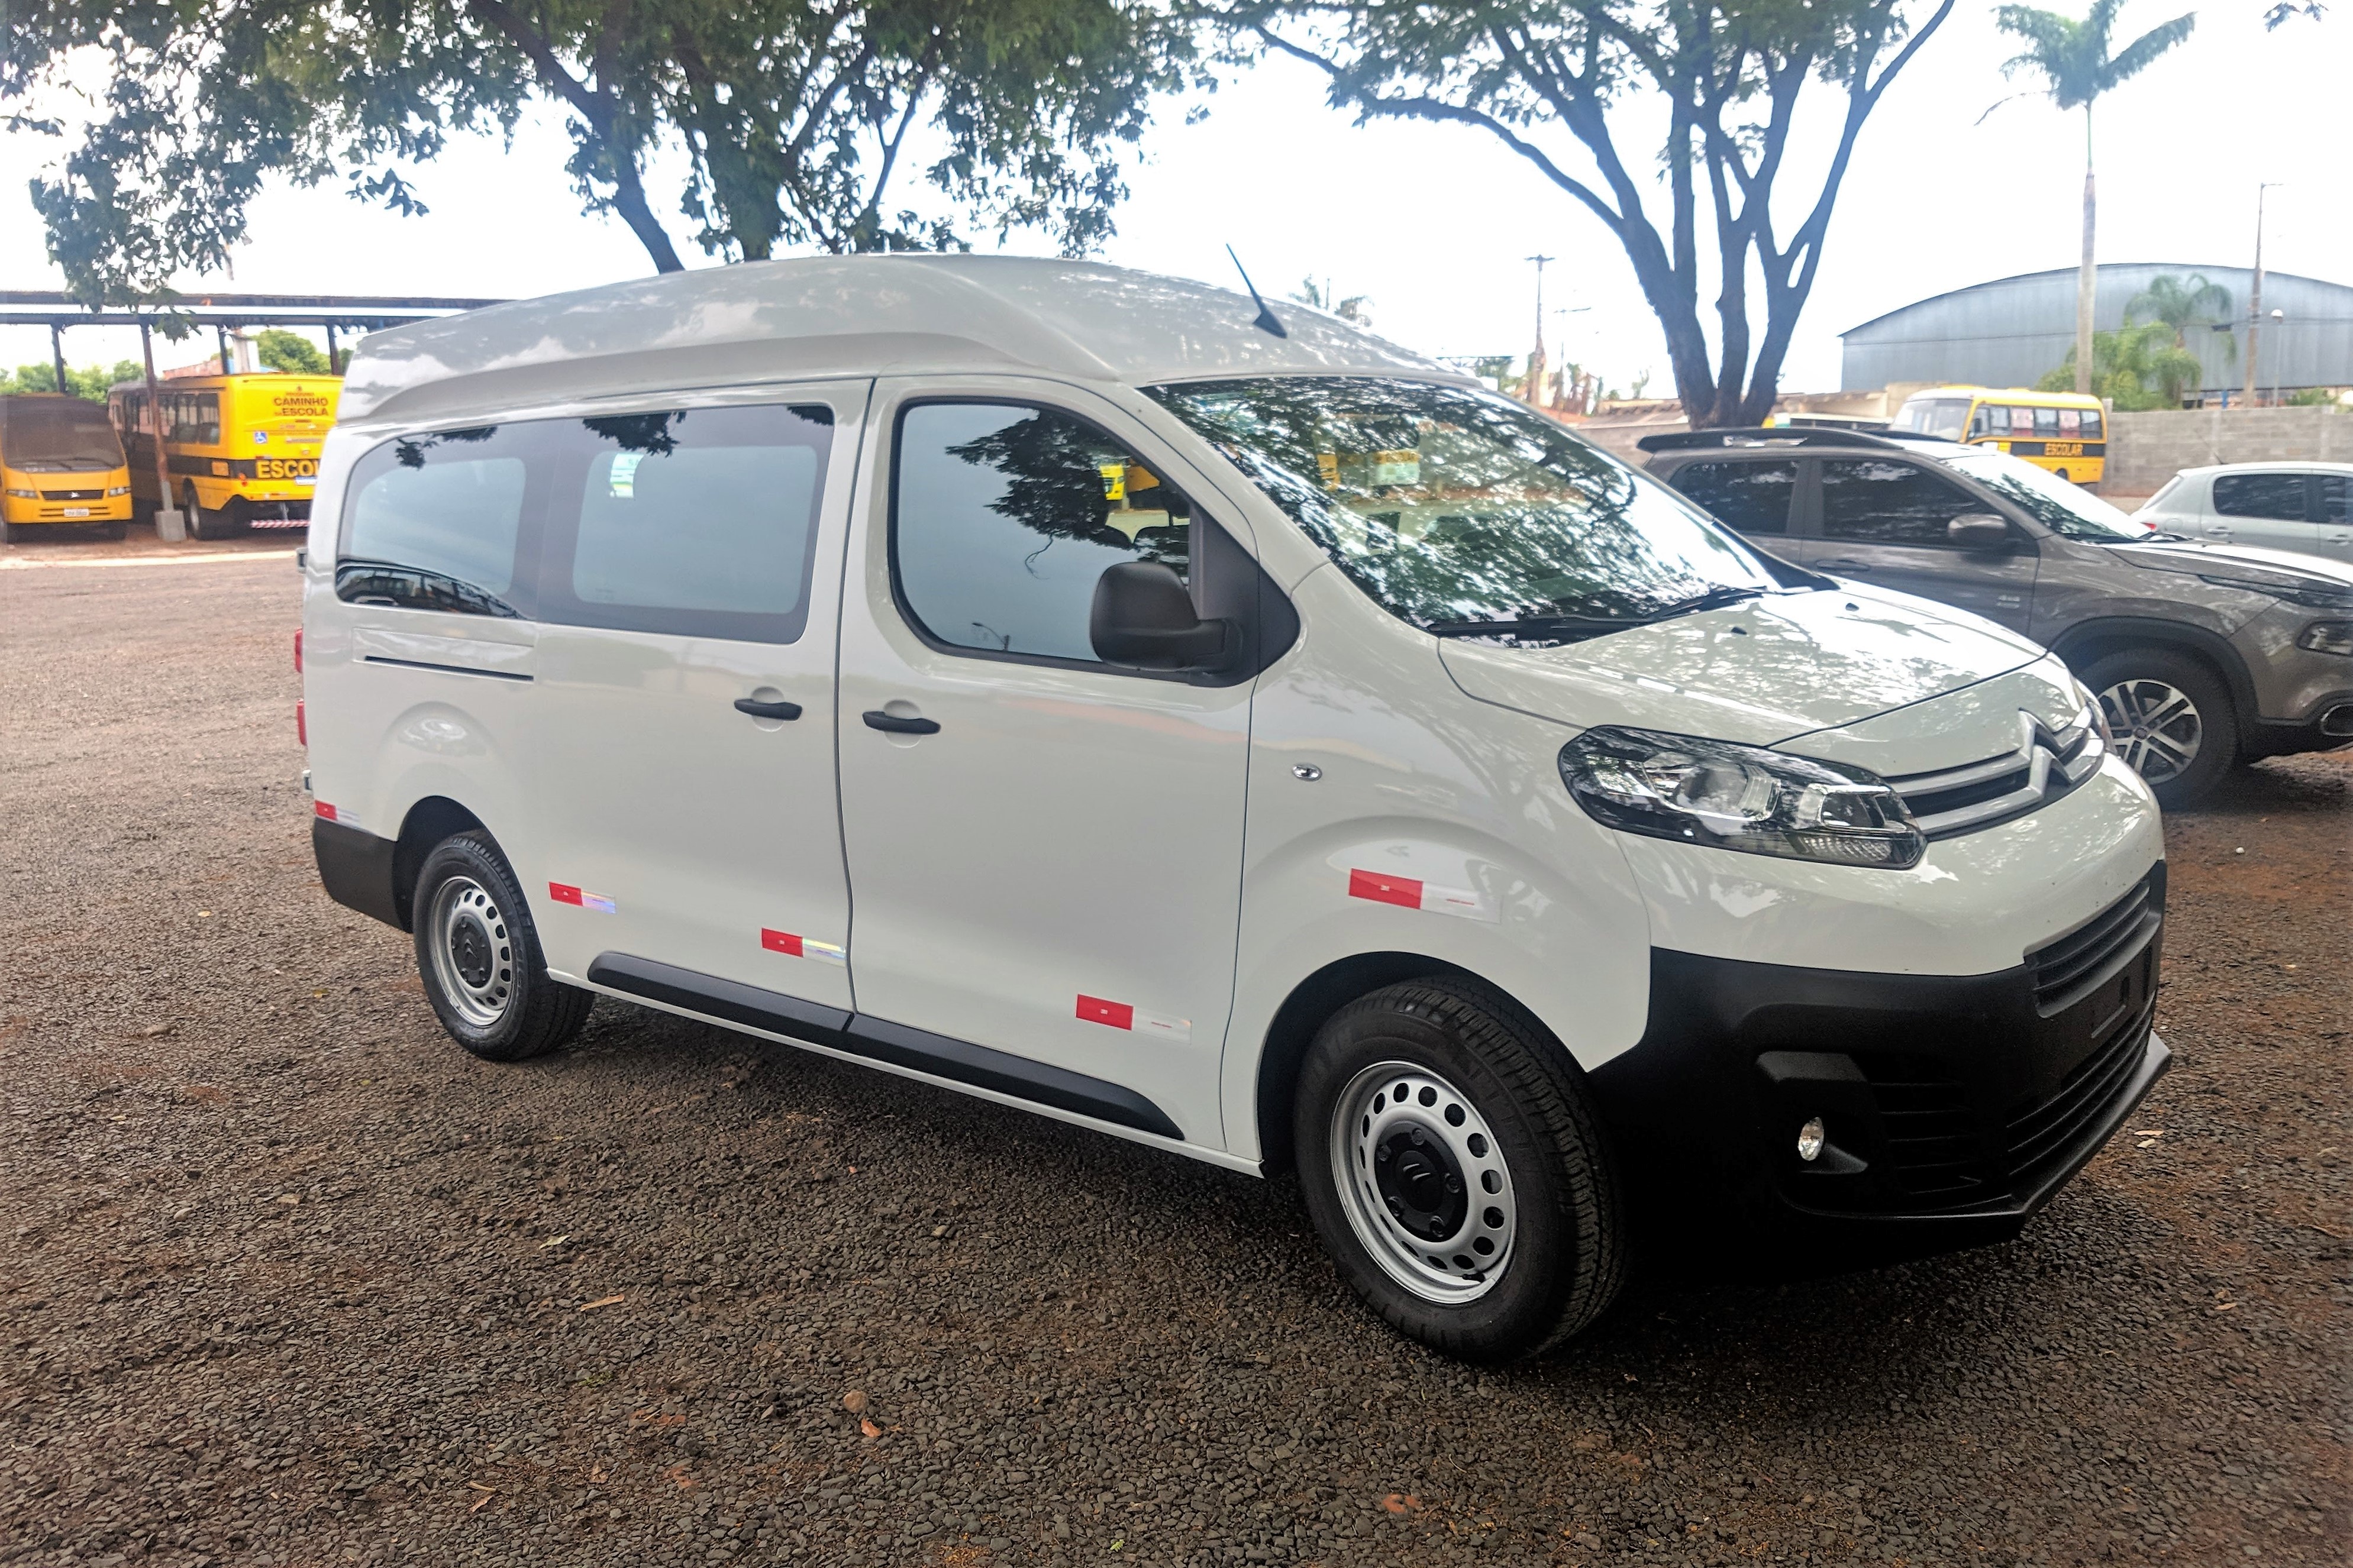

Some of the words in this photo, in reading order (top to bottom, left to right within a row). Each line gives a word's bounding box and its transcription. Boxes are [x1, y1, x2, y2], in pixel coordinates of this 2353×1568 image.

[273, 397, 328, 406] CAMINHO
[282, 408, 328, 416] ESCOLA
[2045, 442, 2083, 455] ESCOLAR
